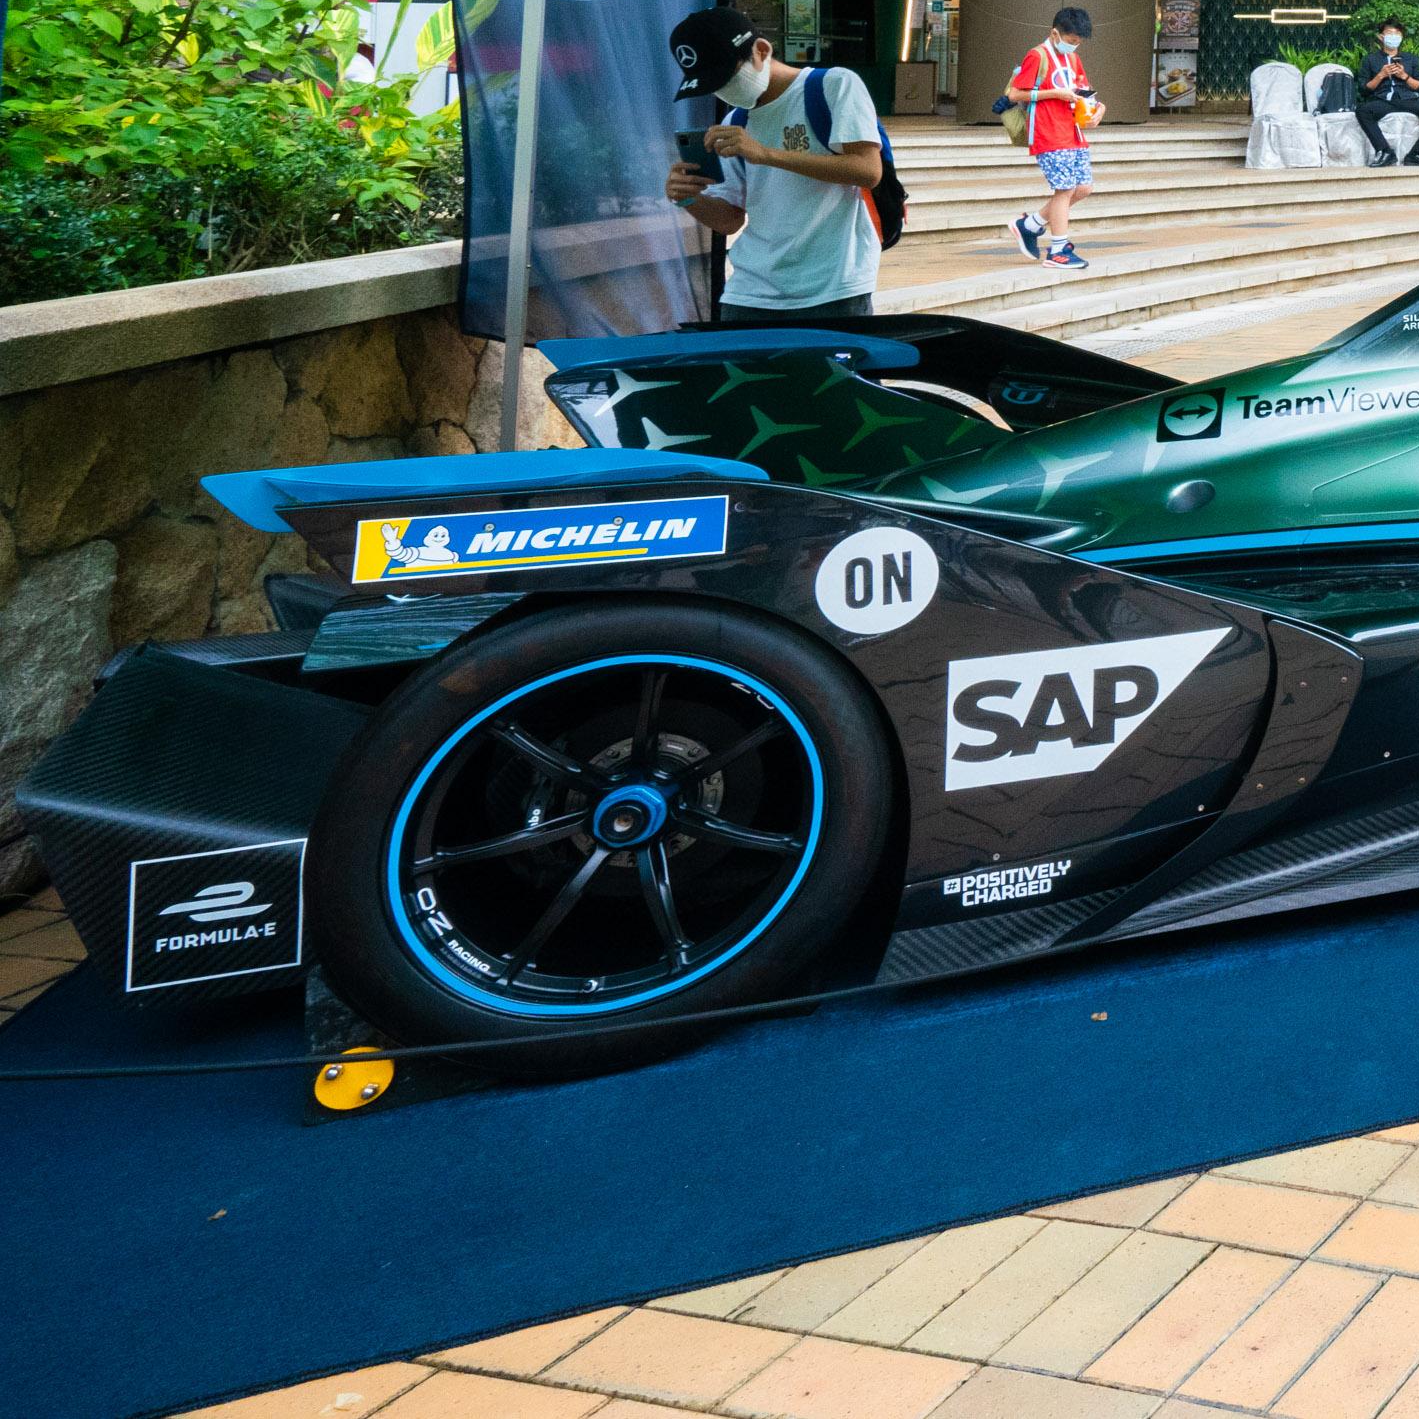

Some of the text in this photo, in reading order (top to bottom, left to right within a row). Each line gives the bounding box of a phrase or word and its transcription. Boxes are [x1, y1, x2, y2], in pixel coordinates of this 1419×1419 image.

[680, 78, 698, 91] 44
[466, 517, 698, 555] MICHELIN
[844, 550, 913, 610] ON
[951, 665, 1160, 764] SAP
[962, 879, 1053, 907] CHARGED
[154, 922, 277, 953] FORMULA-E
[448, 939, 492, 973] RACING
